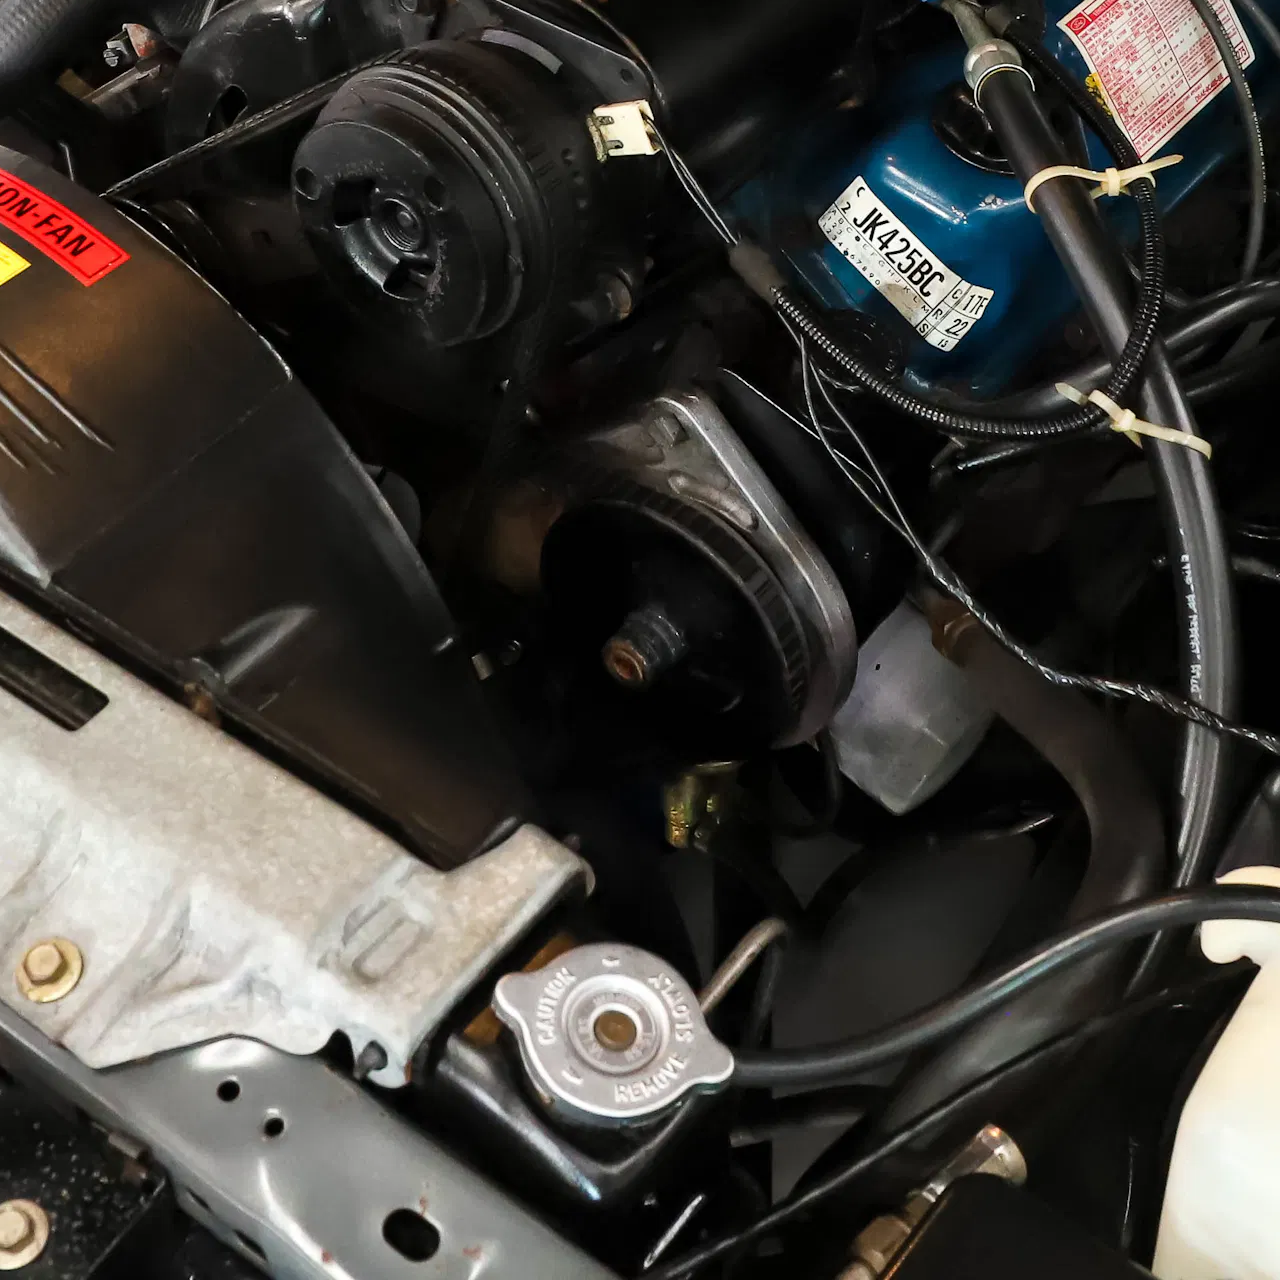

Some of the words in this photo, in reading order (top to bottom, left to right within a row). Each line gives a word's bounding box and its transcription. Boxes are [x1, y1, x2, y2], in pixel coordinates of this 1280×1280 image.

[856, 186, 866, 198] C
[841, 201, 851, 214] 2
[853, 207, 945, 298] JK425BC
[946, 319, 969, 337] 22
[962, 294, 988, 315] 17F
[535, 967, 577, 1045] CAUTION
[648, 972, 695, 1044] SLOWLY
[613, 1051, 689, 1105] REMOVE
